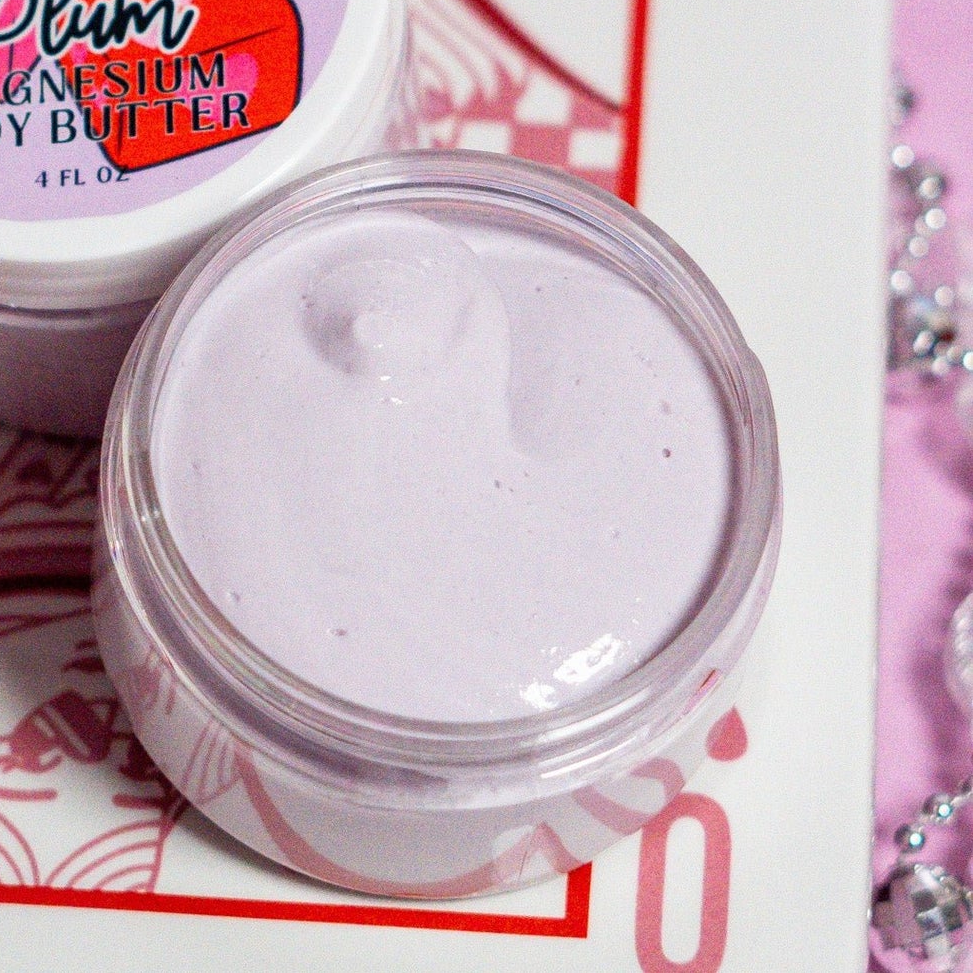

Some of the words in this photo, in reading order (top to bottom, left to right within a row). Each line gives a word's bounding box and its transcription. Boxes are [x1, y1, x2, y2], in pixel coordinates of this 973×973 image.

[51, 93, 250, 144] BUTTER
[34, 170, 49, 188] 4
[59, 168, 86, 187] FL
